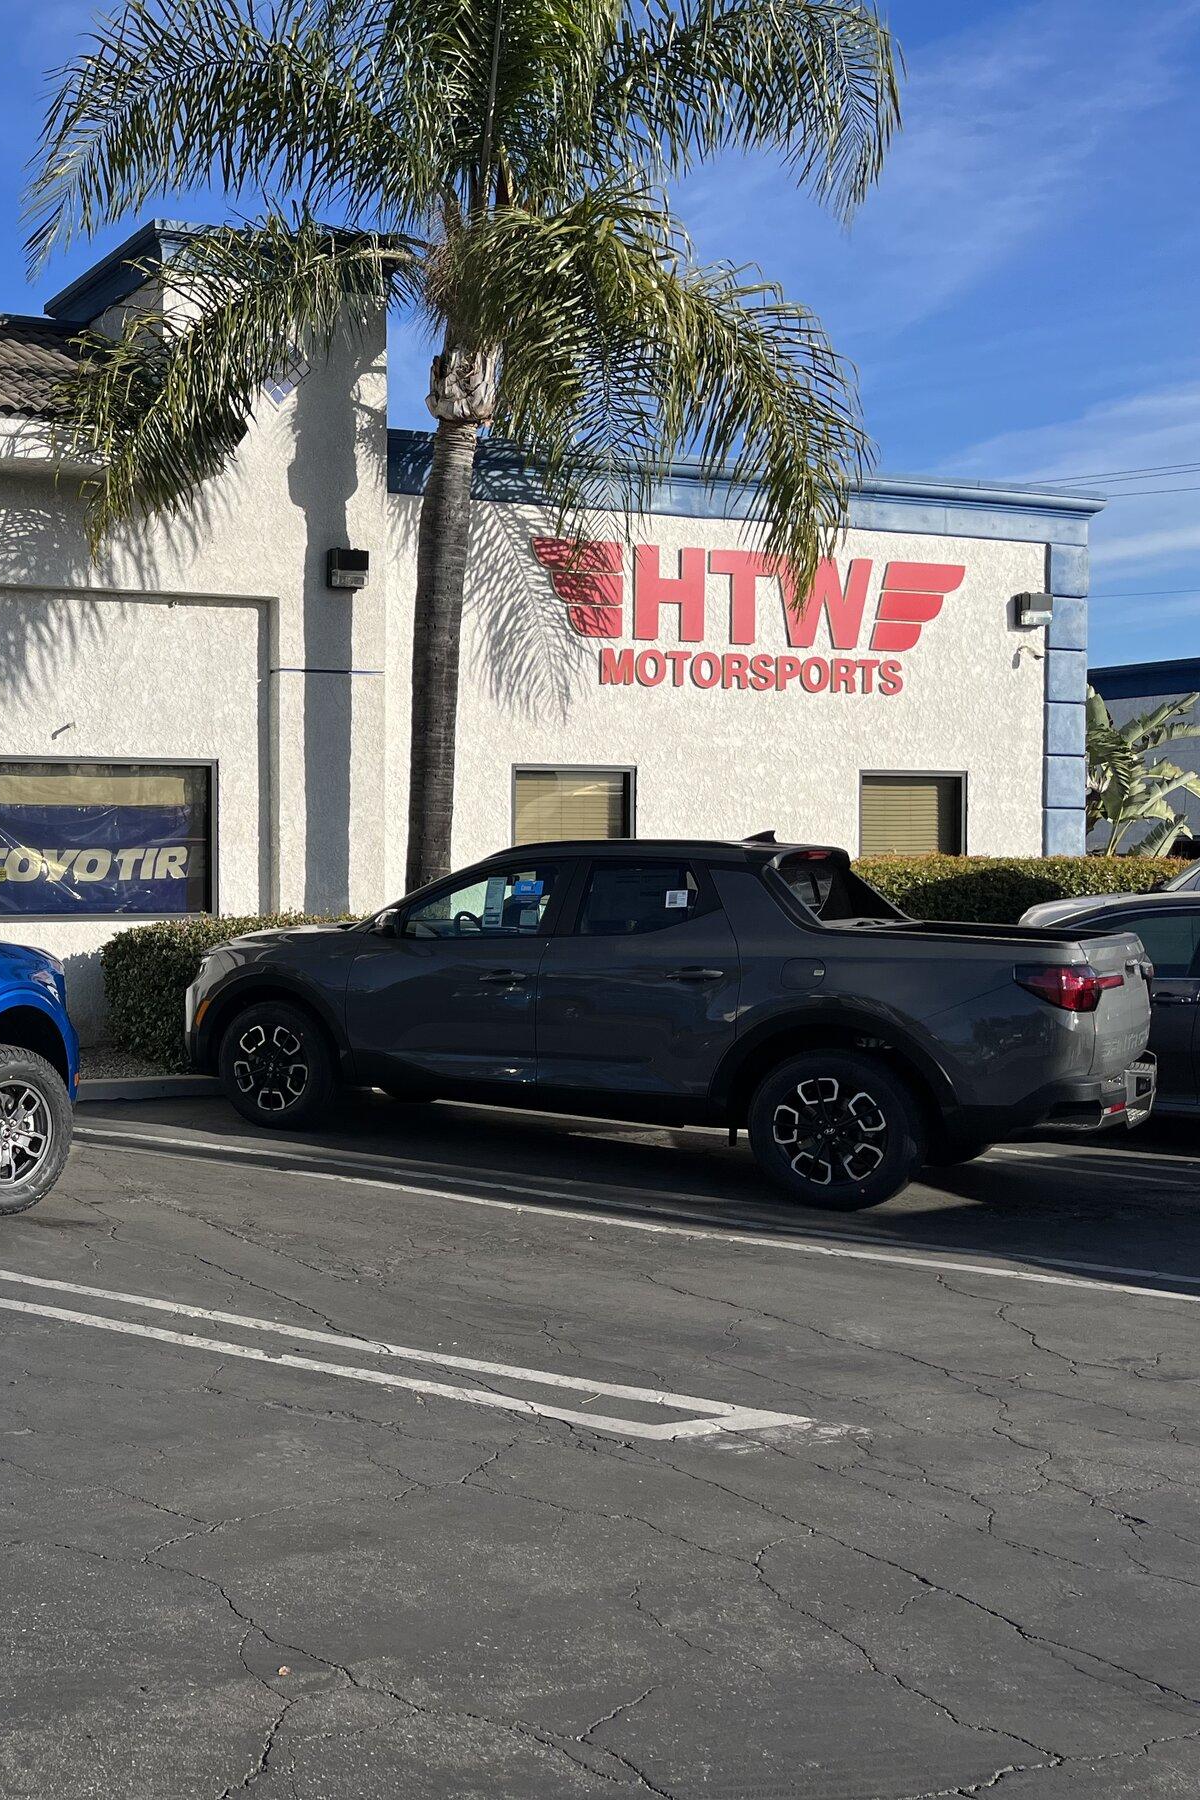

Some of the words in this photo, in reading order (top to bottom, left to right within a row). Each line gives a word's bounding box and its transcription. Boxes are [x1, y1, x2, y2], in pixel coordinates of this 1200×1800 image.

[633, 545, 873, 650] HTW
[600, 648, 903, 695] MOTORSPORTS
[115, 846, 205, 880] TIR
